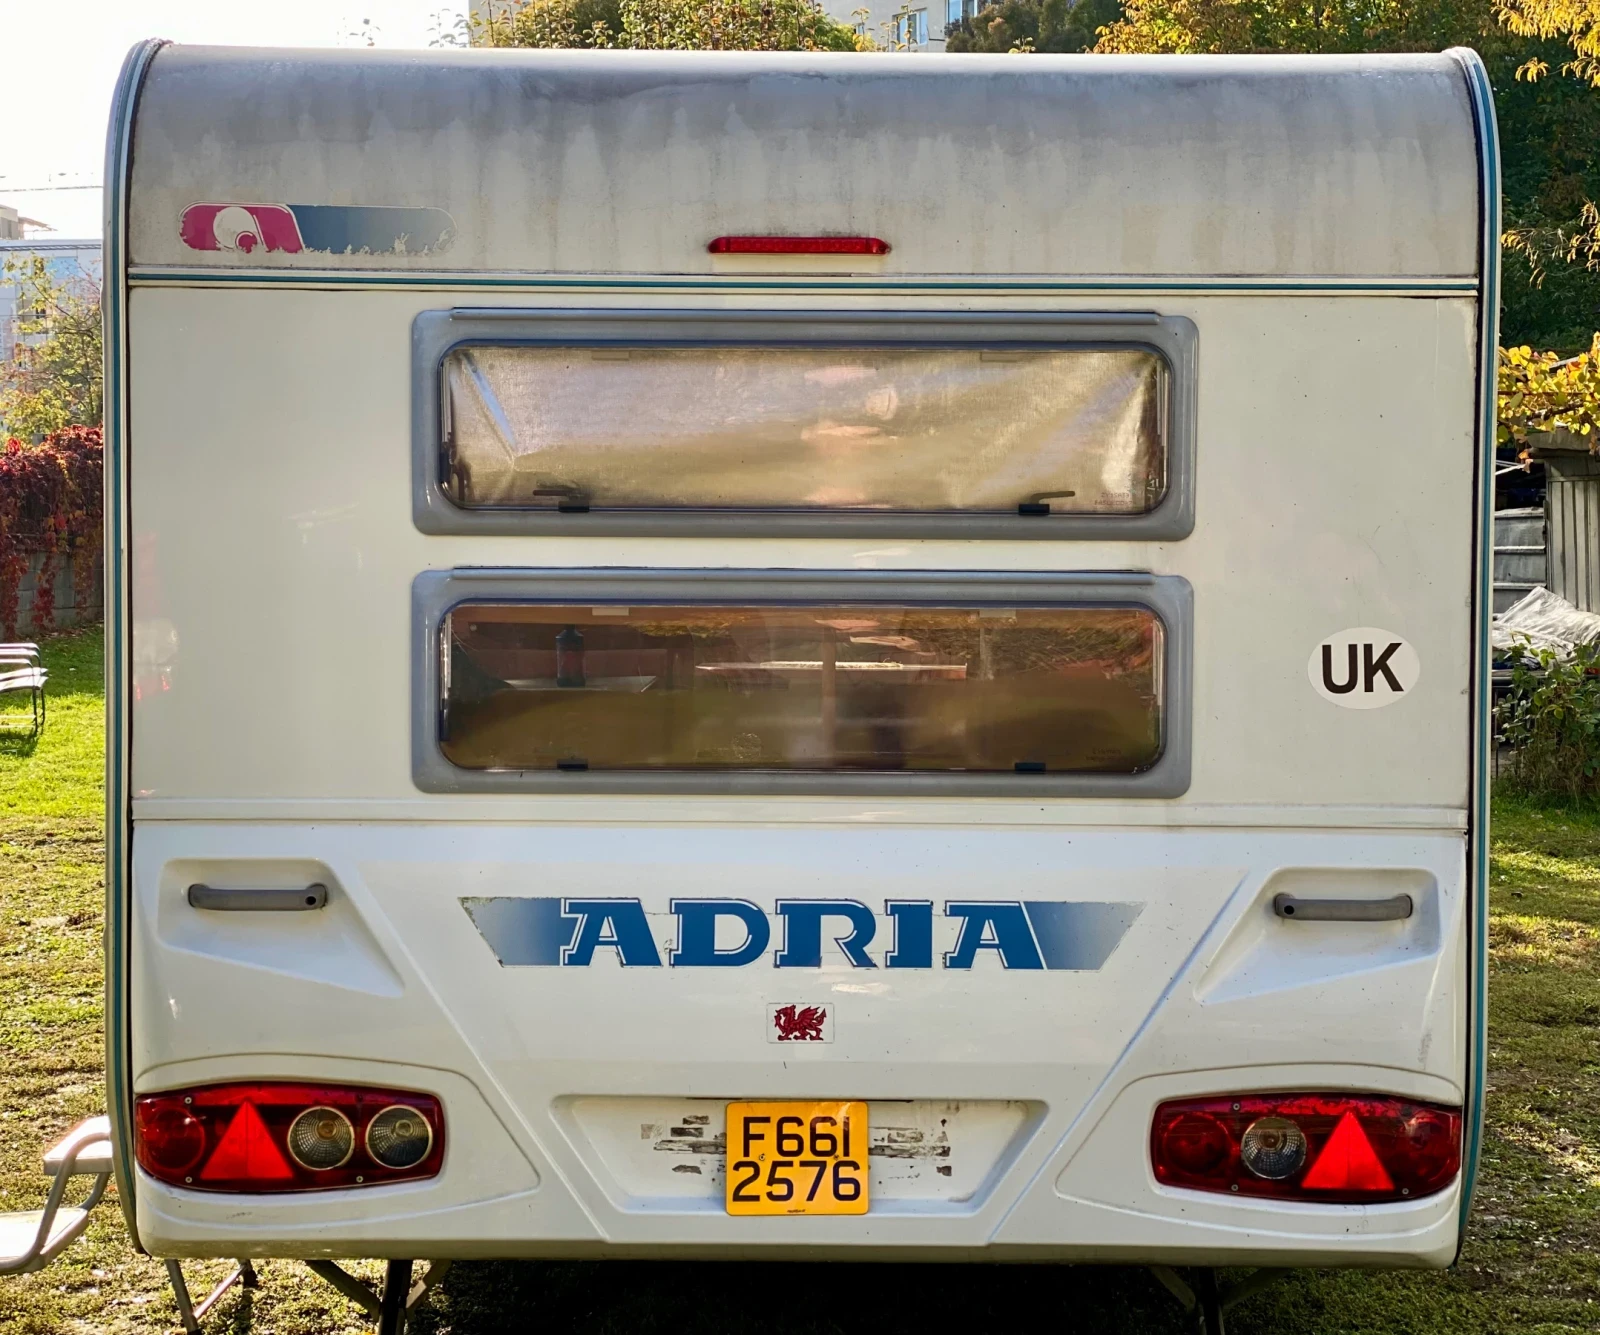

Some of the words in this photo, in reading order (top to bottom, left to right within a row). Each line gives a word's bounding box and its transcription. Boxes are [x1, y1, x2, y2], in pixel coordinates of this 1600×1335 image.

[1321, 642, 1404, 694] UK
[562, 897, 1045, 970] ADRIA
[743, 1116, 850, 1157] F661
[732, 1160, 861, 1202] 2576
